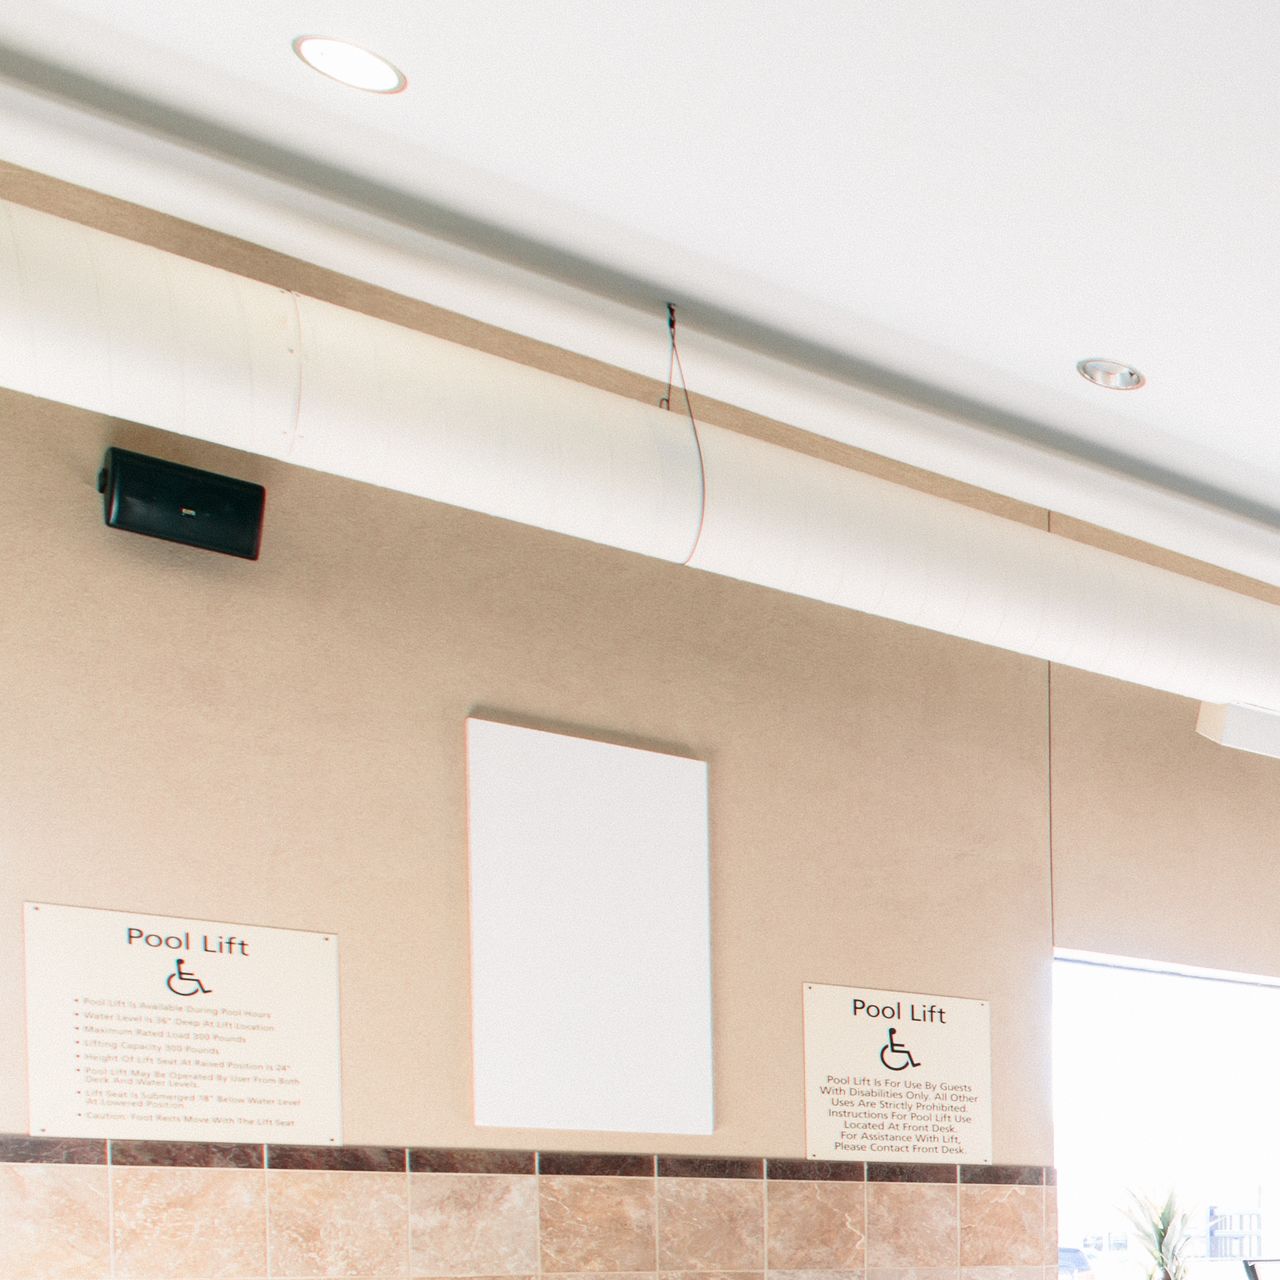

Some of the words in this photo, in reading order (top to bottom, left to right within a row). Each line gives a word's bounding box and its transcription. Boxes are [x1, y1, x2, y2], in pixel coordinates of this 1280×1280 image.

[127, 927, 190, 951] Pool
[203, 934, 250, 957] Lift
[140, 1002, 183, 1012] Available
[187, 1006, 218, 1016] During
[221, 1008, 241, 1016] Pool
[852, 999, 901, 1020] Pool
[911, 1004, 947, 1024] Lift
[84, 1012, 113, 1020] Water
[117, 1014, 142, 1022] Level
[237, 1023, 274, 1031] Location
[85, 1026, 132, 1035] Maximum
[137, 1029, 163, 1037] Rated
[828, 1075, 850, 1085] Pool
[854, 1077, 871, 1086] Lift
[875, 1078, 882, 1087] Is
[885, 1079, 900, 1088] For
[904, 1080, 922, 1089] Use
[926, 1081, 936, 1092] By
[940, 1082, 972, 1092] Guests
[820, 1086, 846, 1096] With
[850, 1088, 903, 1099] Disabilities
[906, 1091, 930, 1102] Only.
[935, 1093, 947, 1101] All
[951, 1094, 978, 1103] Other
[832, 1098, 855, 1107] Uses
[858, 1100, 876, 1108] Are
[880, 1101, 912, 1112] Strictly
[916, 1103, 968, 1113] Prohibited.
[828, 1109, 888, 1120] Instructions
[891, 1112, 907, 1121] For
[911, 1113, 932, 1122] Pool
[935, 1114, 951, 1123] Lift
[955, 1115, 972, 1124] Use
[844, 1120, 884, 1130] Located
[888, 1122, 899, 1131] At
[903, 1123, 928, 1132] Front
[932, 1124, 957, 1133] Desk.
[841, 1131, 857, 1140] For
[861, 1132, 912, 1142] Assistance
[915, 1134, 939, 1143] With
[942, 1135, 961, 1145] Lift,
[835, 1142, 867, 1151] Please
[870, 1143, 909, 1153] Contact
[913, 1144, 938, 1154] Front
[941, 1145, 967, 1154] Desk.
